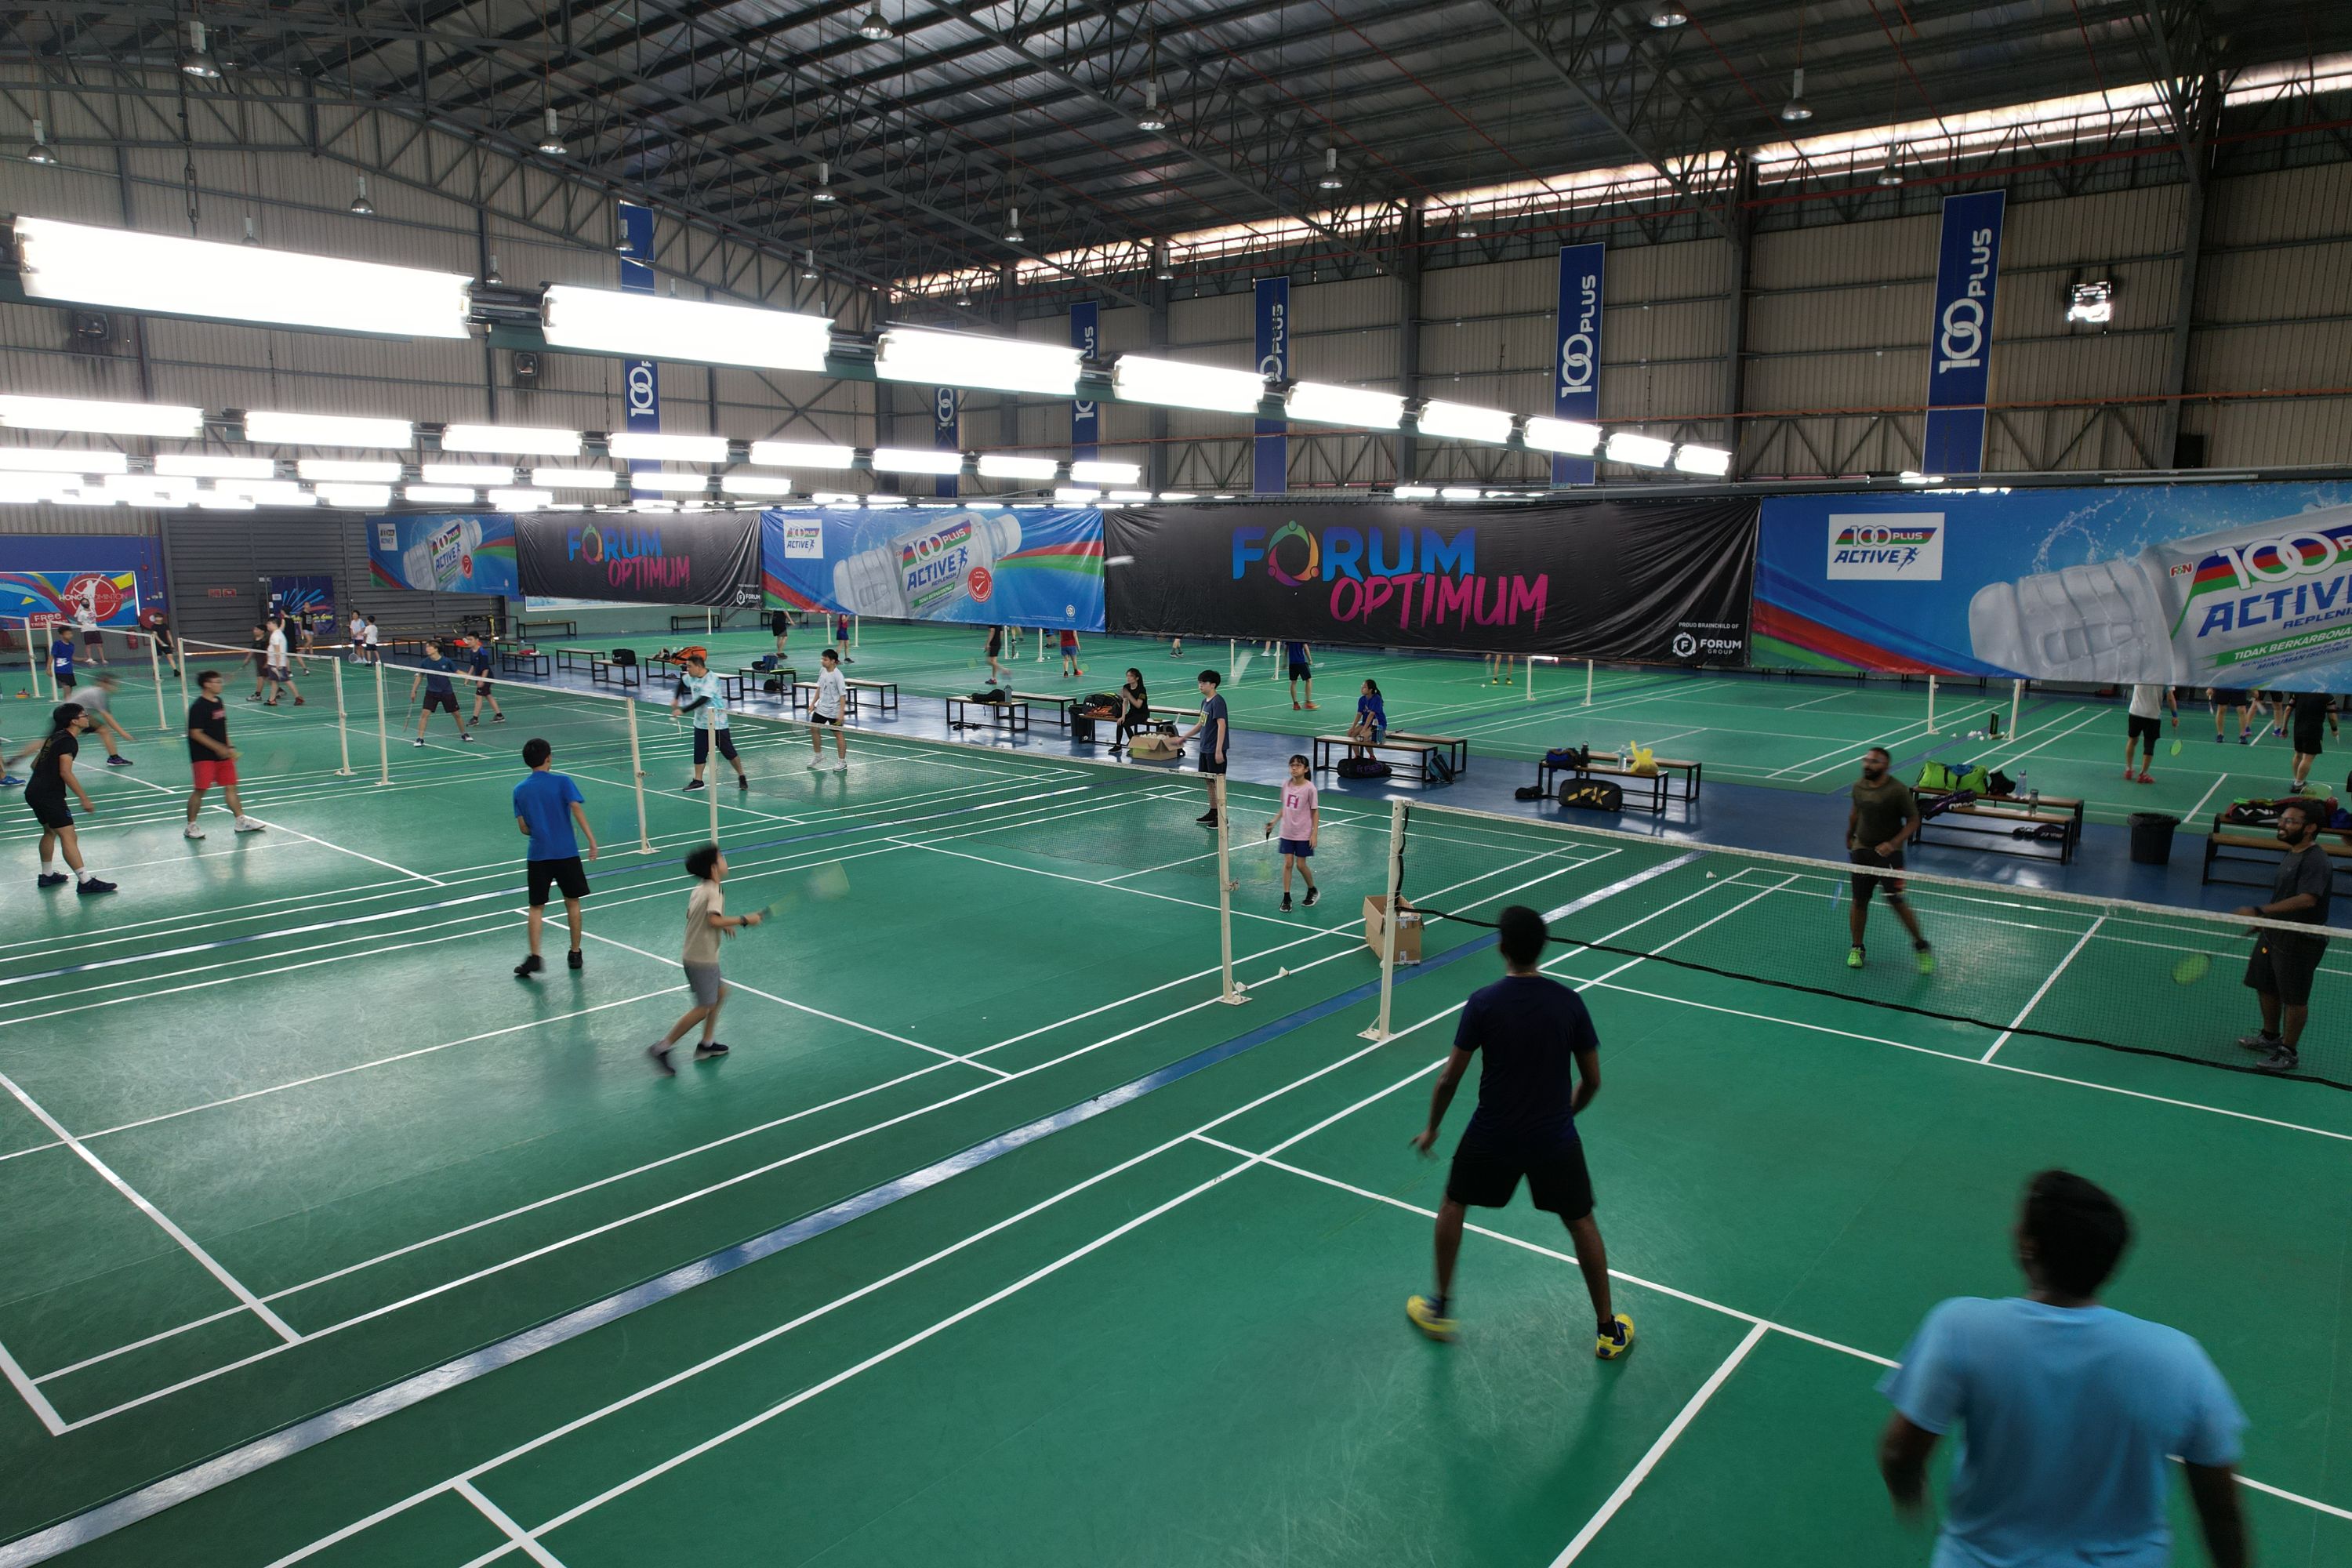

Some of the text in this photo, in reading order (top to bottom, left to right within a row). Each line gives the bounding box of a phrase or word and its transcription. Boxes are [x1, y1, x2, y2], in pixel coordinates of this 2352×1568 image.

[1232, 520, 1475, 586] FORUM
[1834, 550, 1900, 563] ACTIVE
[608, 555, 690, 590] OPTIMUM
[907, 554, 956, 591] ACTIVE
[1330, 572, 1548, 632] OPTIMUM
[2197, 574, 2352, 637] ACTIV
[1700, 638, 1742, 649] FORUM
[2234, 646, 2267, 660] TIDAK
[2268, 626, 2352, 653] BERKARBONA
